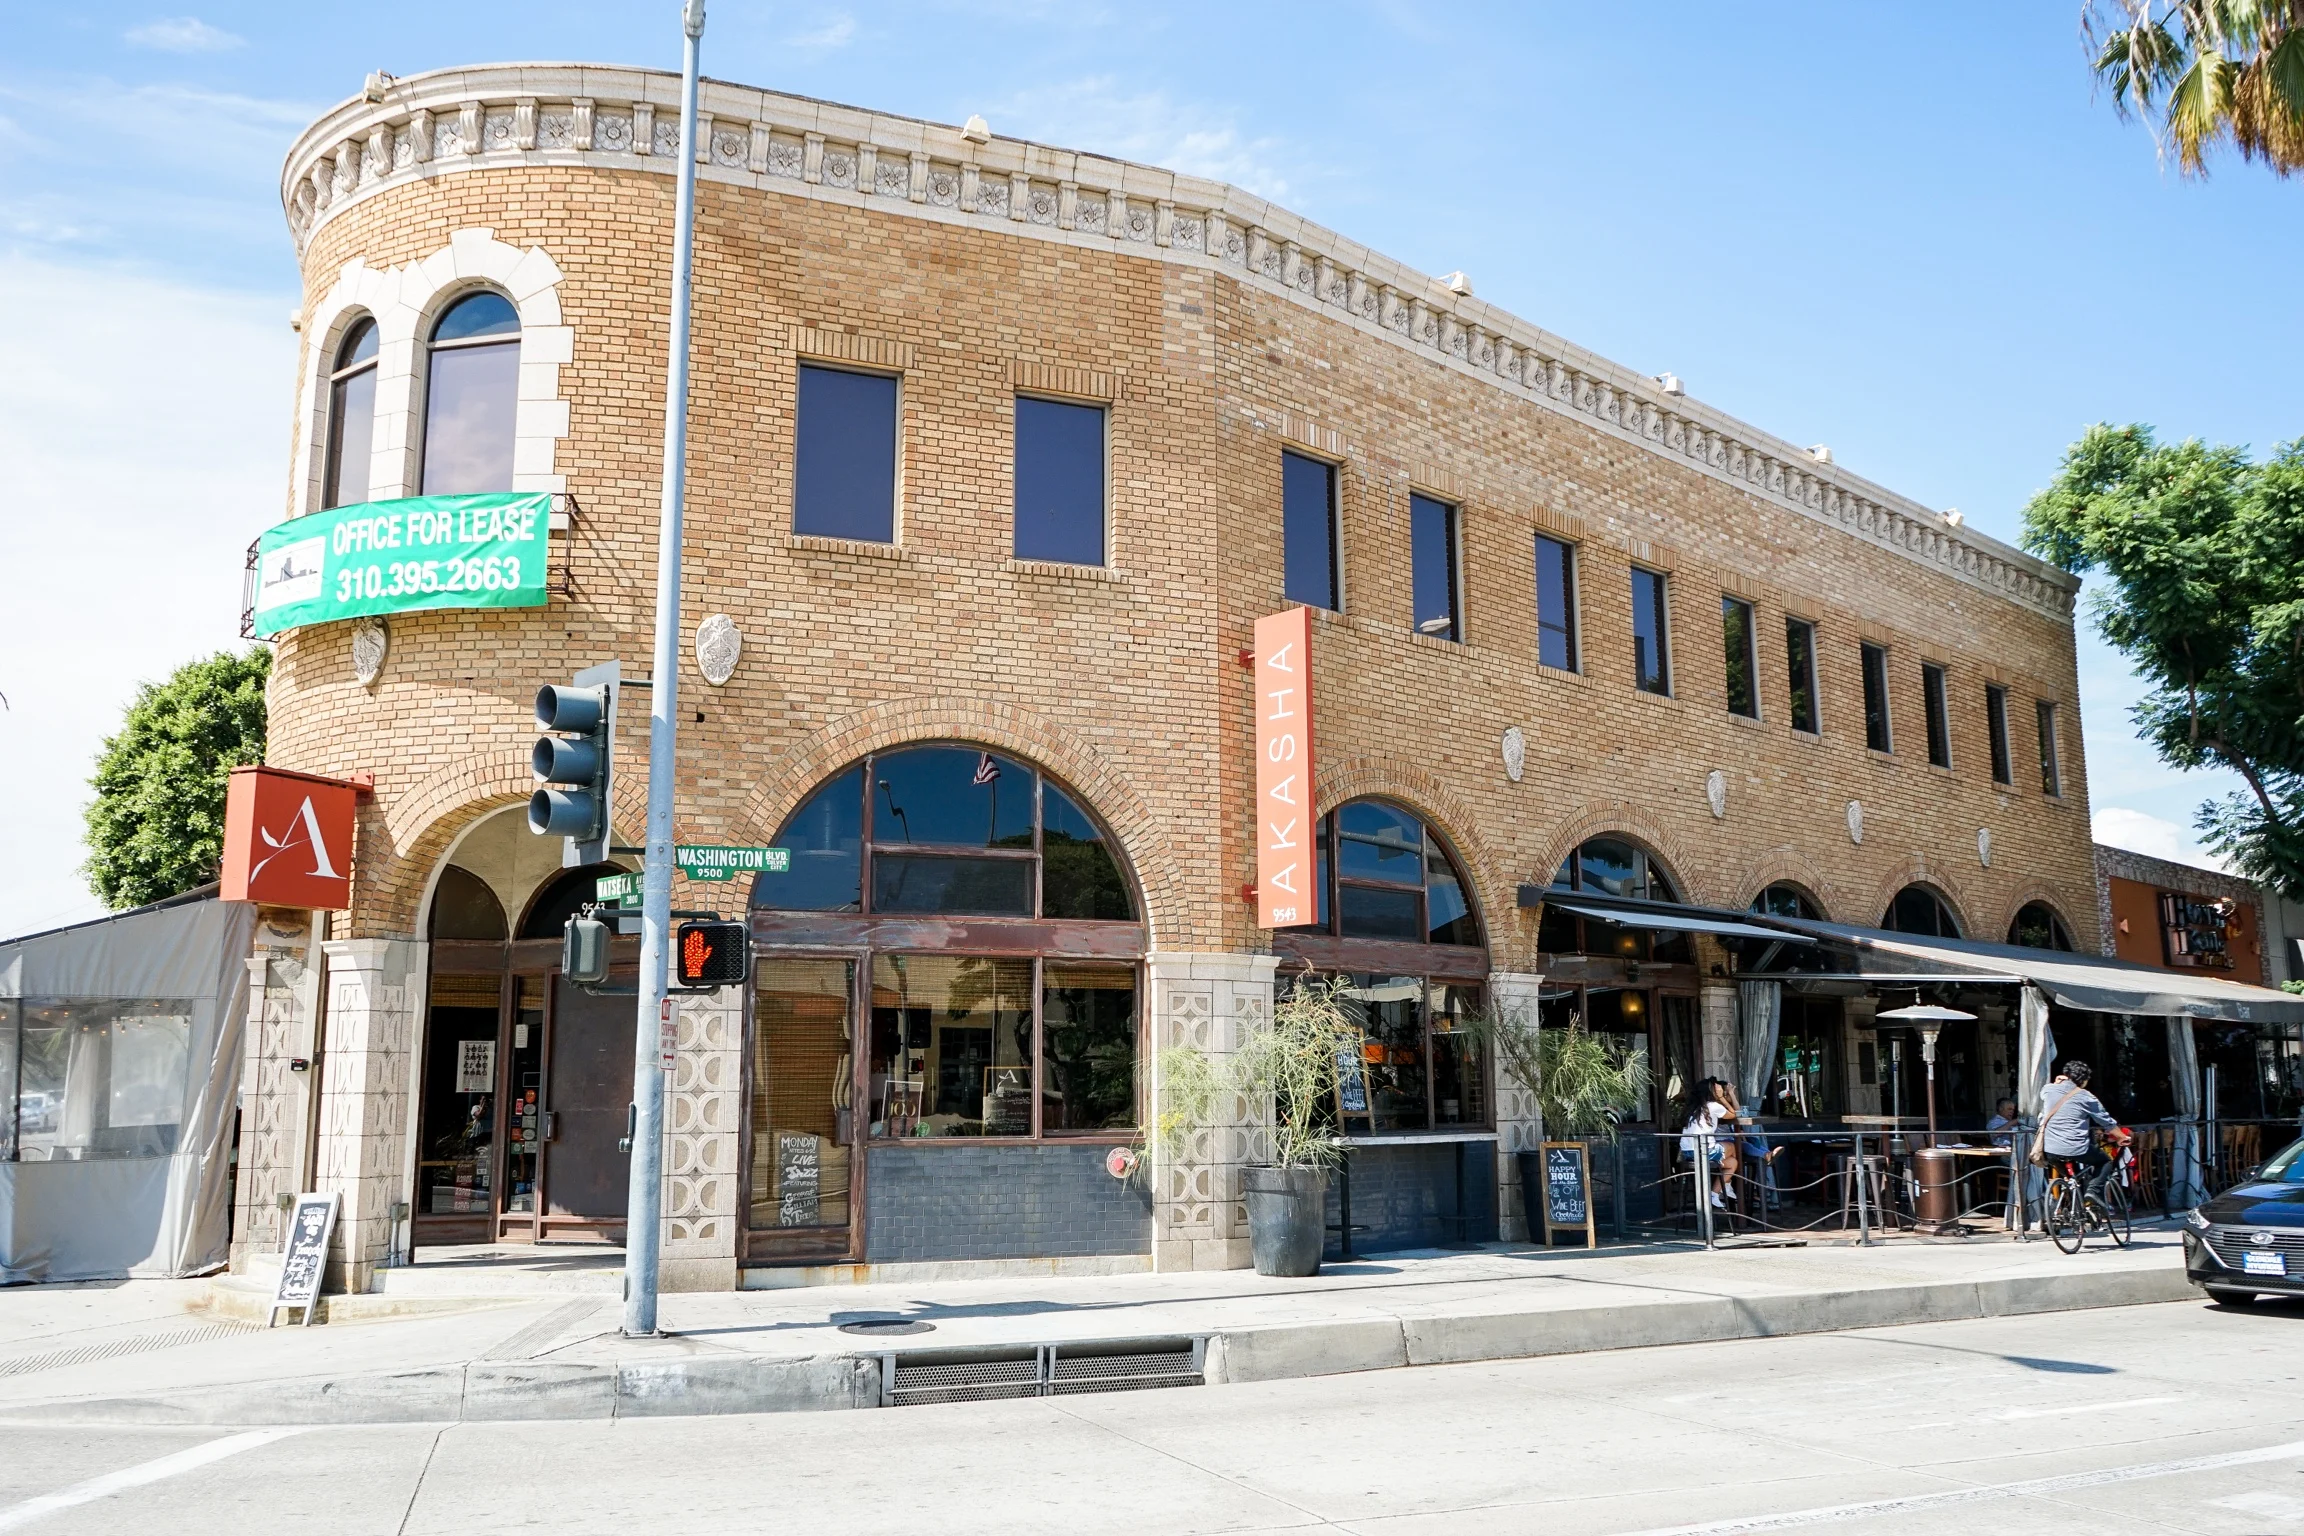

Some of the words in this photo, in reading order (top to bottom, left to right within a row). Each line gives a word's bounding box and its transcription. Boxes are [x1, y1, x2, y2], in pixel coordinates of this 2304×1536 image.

[333, 515, 401, 557] OFFICE
[406, 511, 452, 546] FOR
[459, 508, 537, 544] LEASE
[336, 555, 521, 602] 310.395.2663
[1267, 642, 1298, 895] AKASHA
[250, 795, 346, 884] A
[677, 848, 764, 868] WASHINGTON
[765, 850, 789, 861] BLVD.
[697, 868, 723, 878] 9500
[597, 876, 632, 898] WATSEKA
[626, 894, 639, 905] 3800
[1273, 907, 1297, 923] 9543
[781, 1136, 819, 1150] MONDAY
[792, 1154, 818, 1166] LIVE
[785, 1165, 819, 1180] JAZZ
[1550, 1172, 1578, 1181] HOUR
